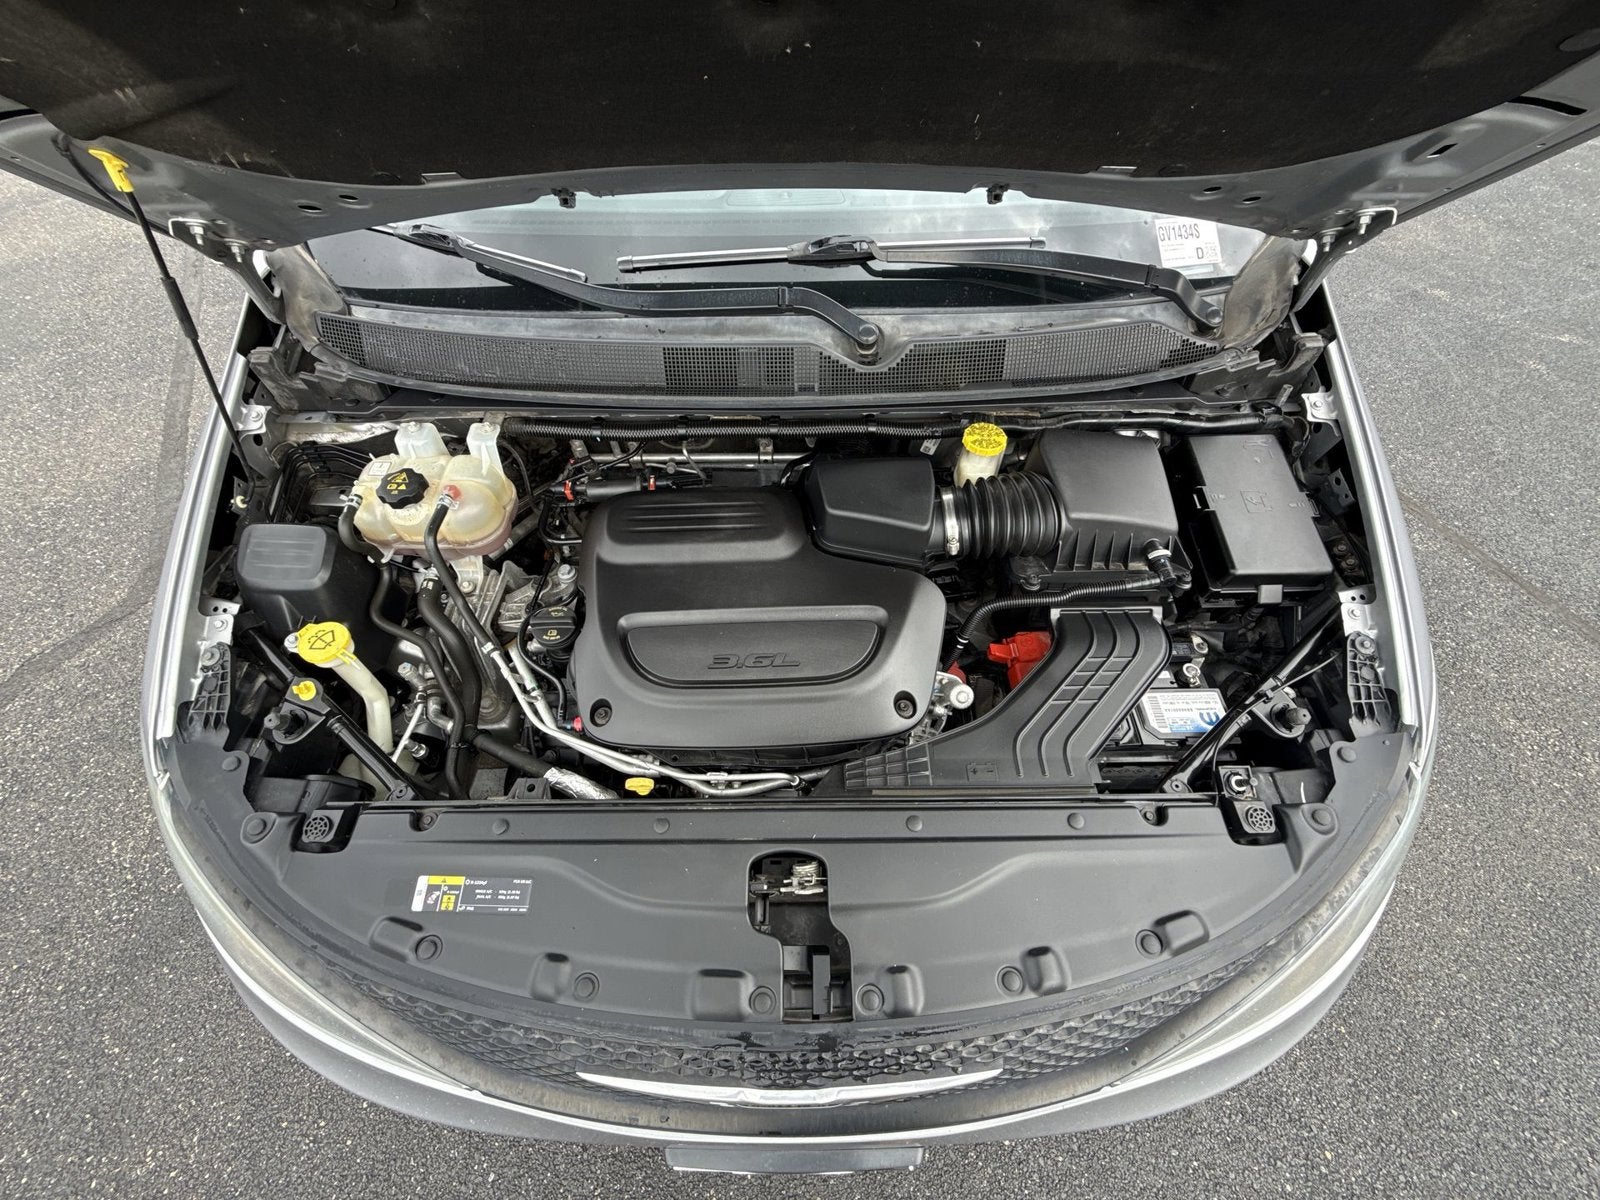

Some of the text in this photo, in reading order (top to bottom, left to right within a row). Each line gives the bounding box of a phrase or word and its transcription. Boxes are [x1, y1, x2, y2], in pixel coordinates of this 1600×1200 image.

[1158, 223, 1200, 242] GV1434S
[1196, 247, 1204, 259] D
[707, 652, 801, 670] 3.6L
